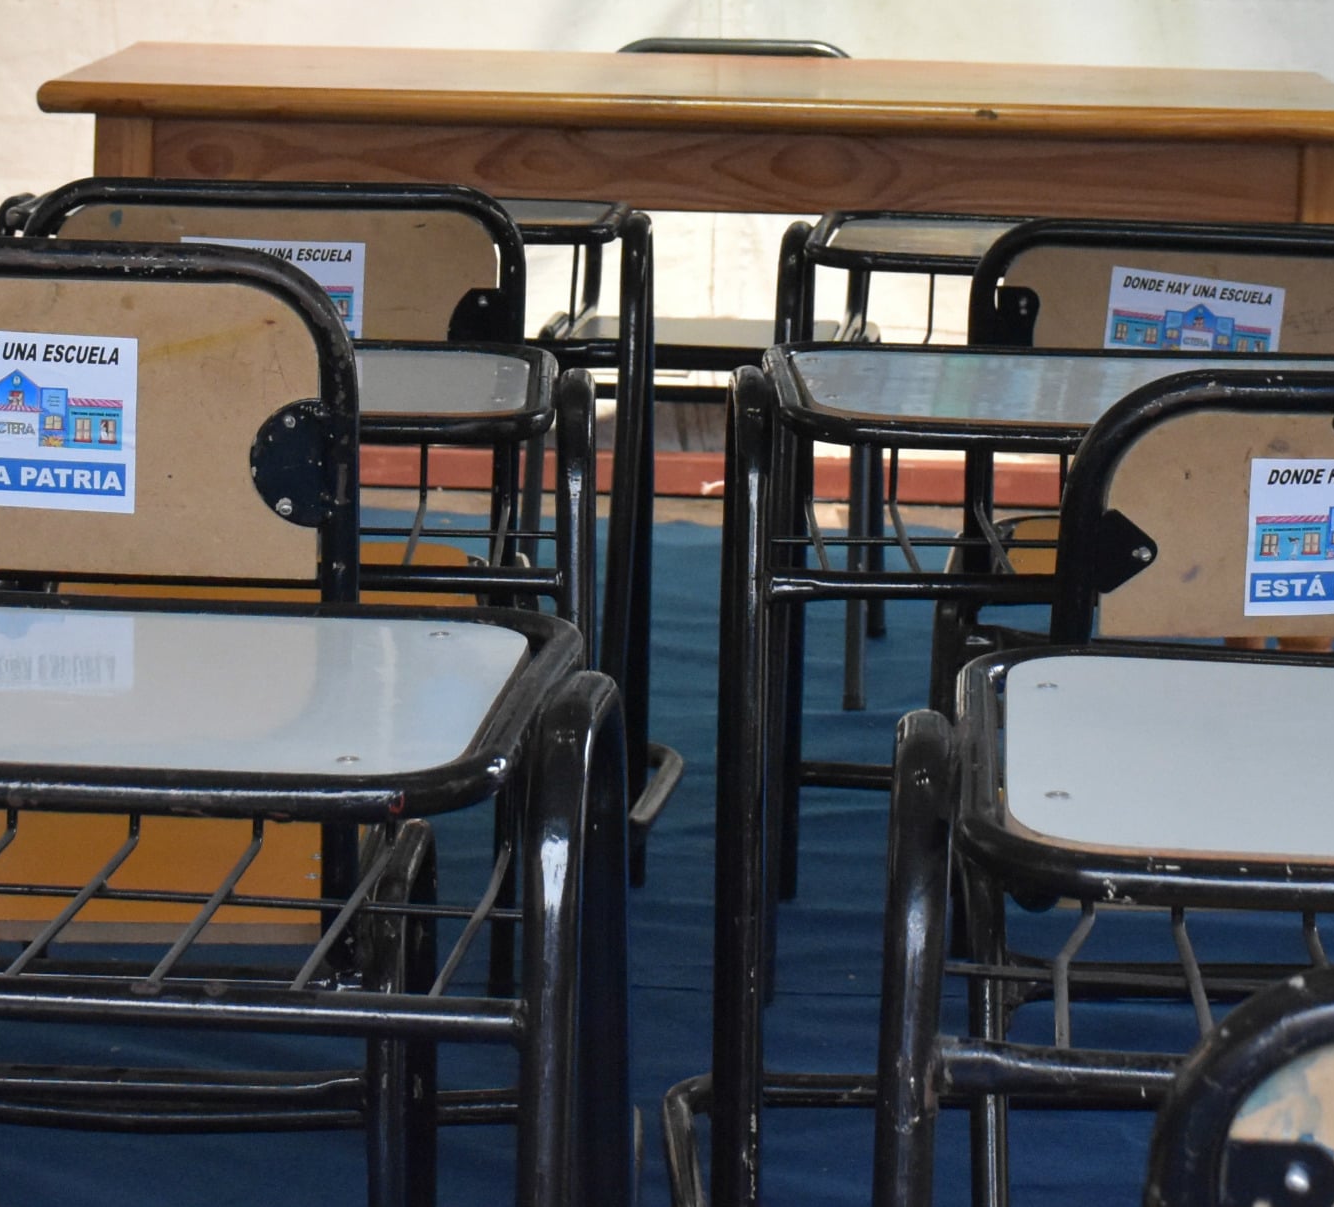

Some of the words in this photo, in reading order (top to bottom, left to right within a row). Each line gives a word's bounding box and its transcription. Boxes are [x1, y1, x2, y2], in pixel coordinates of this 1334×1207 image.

[296, 248, 352, 262] ESCUELA
[1123, 276, 1164, 292] DONDE
[1165, 281, 1191, 294] HAY
[1192, 285, 1216, 299] UNA
[1219, 288, 1272, 305] ESCUELA
[2, 343, 37, 362] UNA
[42, 344, 119, 365] ESCUELA
[20, 467, 122, 491] PATRIA
[1267, 468, 1325, 485] DONDE
[1254, 575, 1326, 598] ESTÁ
